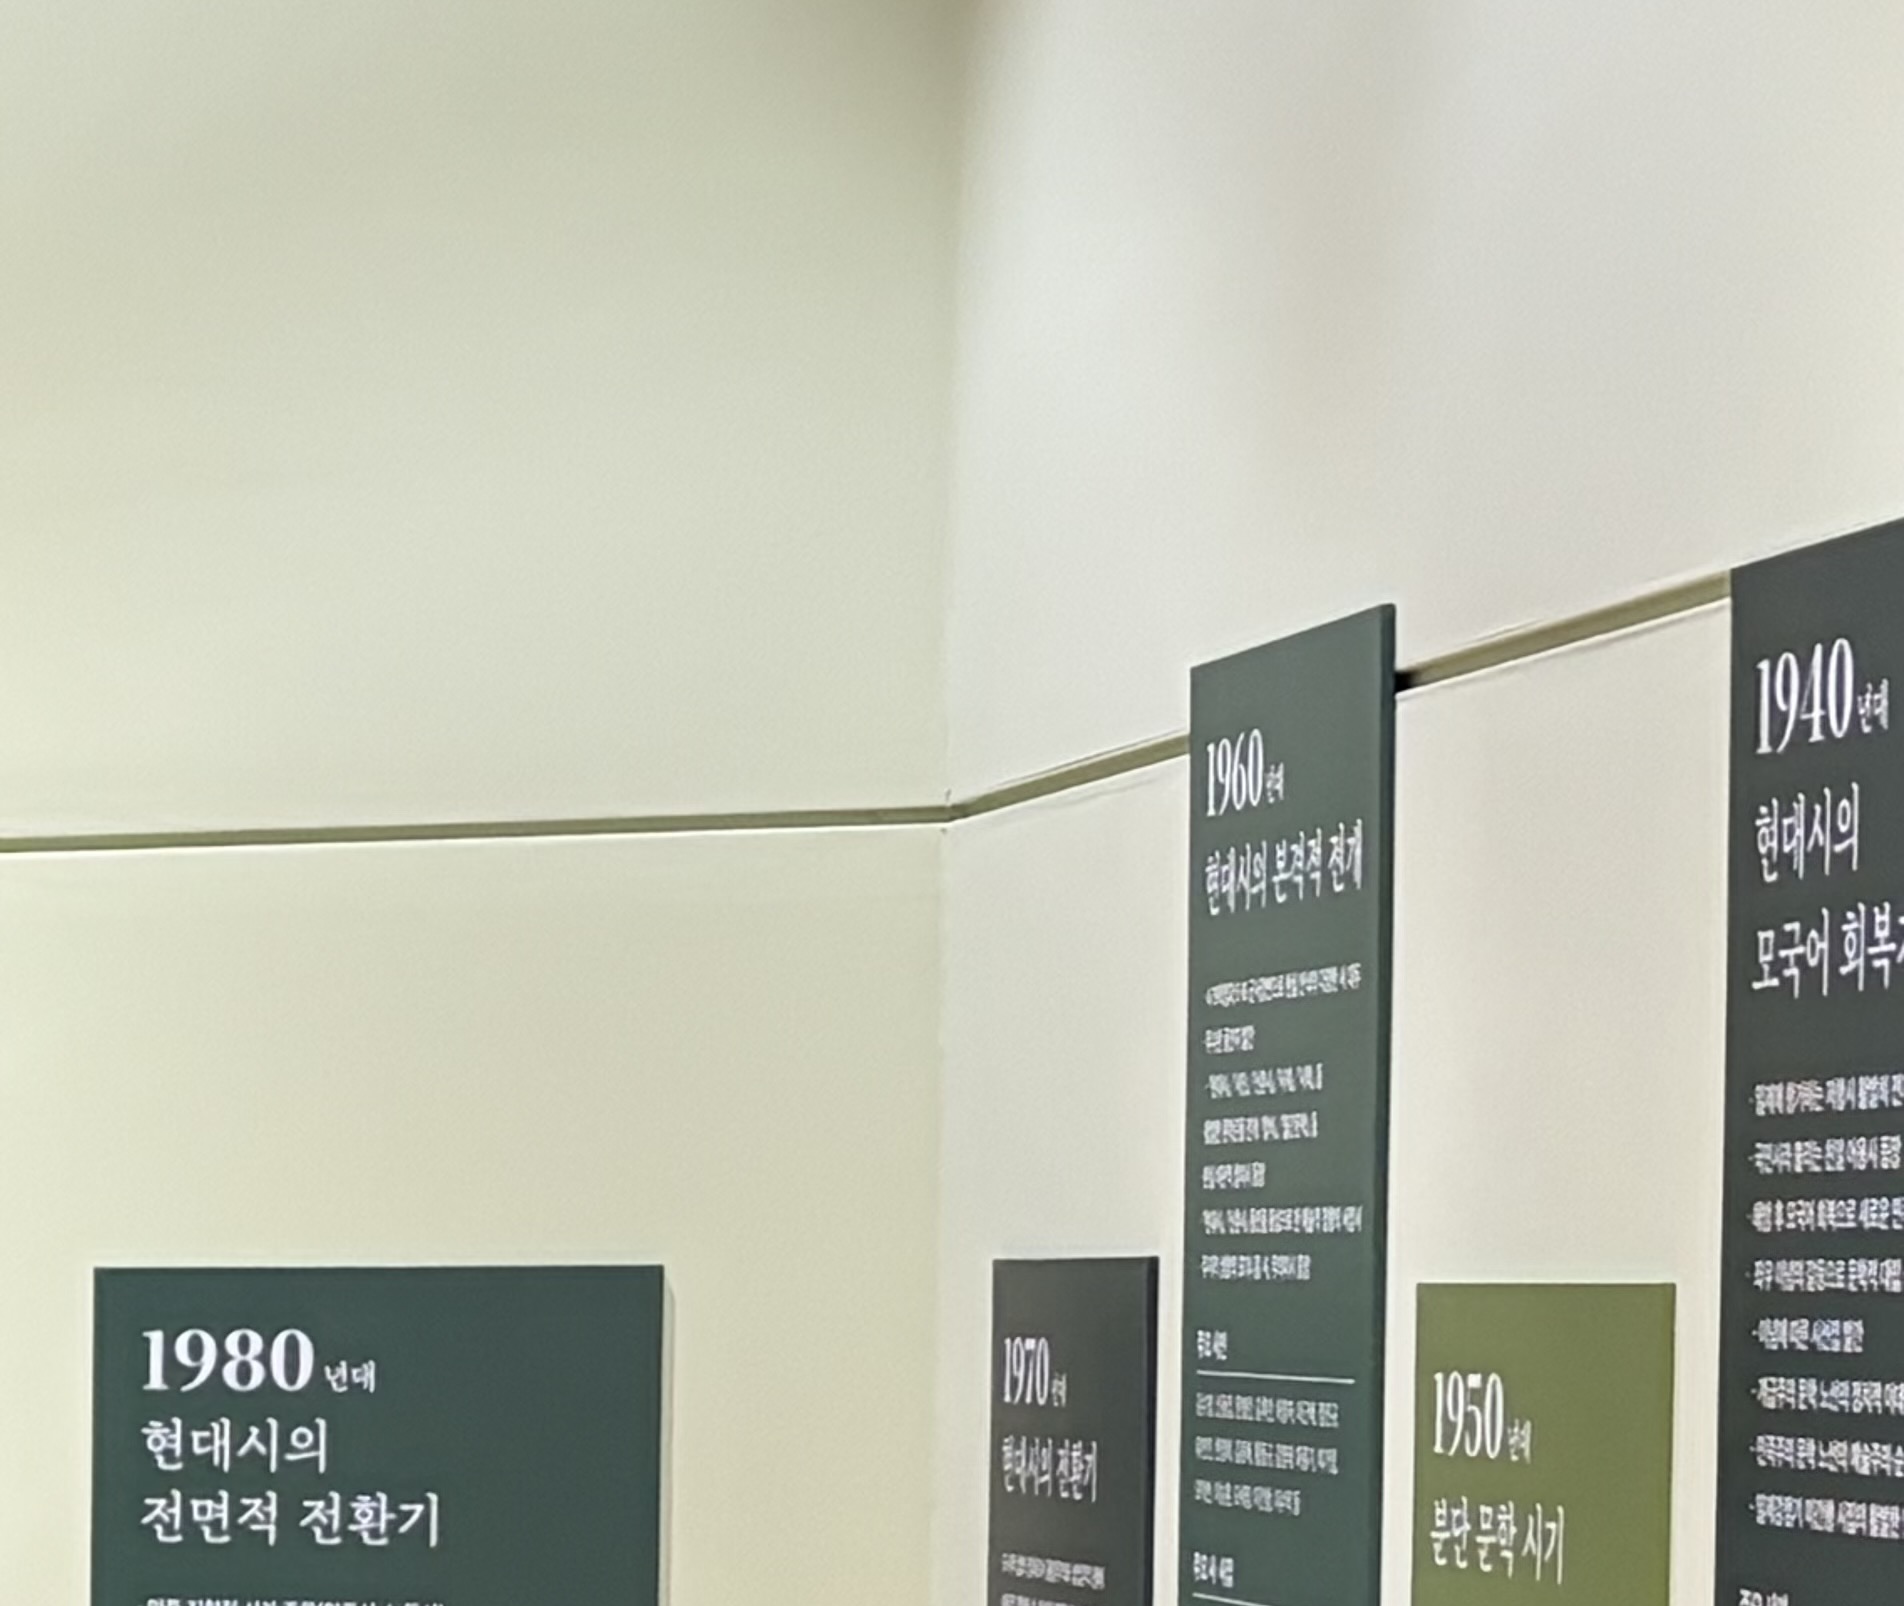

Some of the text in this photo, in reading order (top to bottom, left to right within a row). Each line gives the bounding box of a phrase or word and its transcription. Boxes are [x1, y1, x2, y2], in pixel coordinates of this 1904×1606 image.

[1755, 637, 1889, 755] 1940 년대
[1206, 728, 1264, 817] 1960
[1205, 818, 1363, 915] 현대시의 본격적 전개
[1754, 781, 1859, 883] 현대시의
[1751, 907, 1829, 1000] 모국어
[142, 1328, 375, 1393] 1980 년대
[1003, 1336, 1050, 1407] 1970
[141, 1416, 326, 1474] 현대시의
[1433, 1371, 1504, 1459] 1950
[140, 1488, 438, 1547] 전면적 전환기
[1430, 1495, 1565, 1585] 분단 문학 시기
